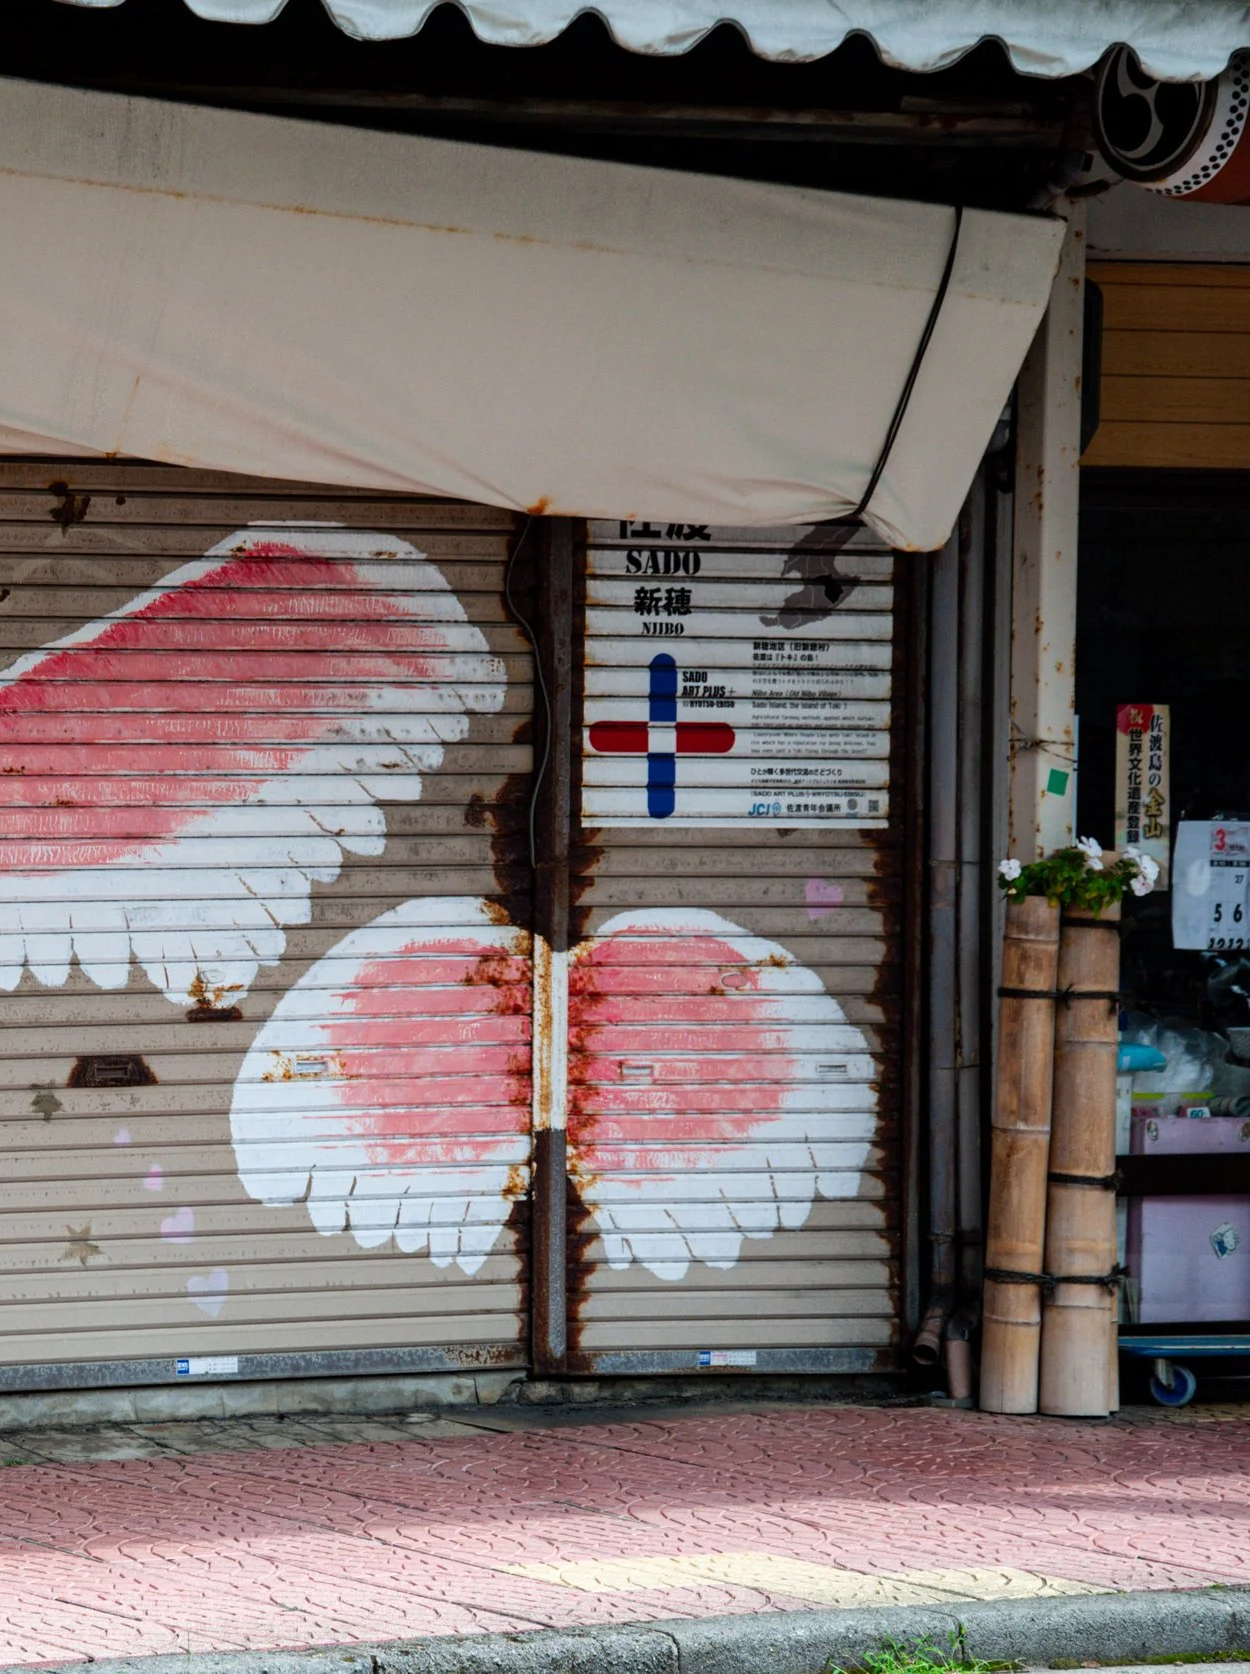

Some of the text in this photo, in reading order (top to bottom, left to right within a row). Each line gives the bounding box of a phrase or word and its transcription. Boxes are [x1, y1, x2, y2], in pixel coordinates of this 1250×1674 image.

[625, 549, 701, 575] SADO
[634, 586, 692, 616] 新穂
[641, 622, 685, 636] NIIBO
[682, 671, 708, 683] SADO
[681, 685, 701, 698] ART
[702, 685, 726, 698] PLUS
[1126, 728, 1144, 845] 世界文化遺産登録
[1143, 713, 1166, 840] 佐渡島の金山
[747, 803, 771, 816] JCI
[1214, 828, 1228, 851] 3
[1234, 874, 1245, 884] 27
[1213, 902, 1243, 923] 5 6
